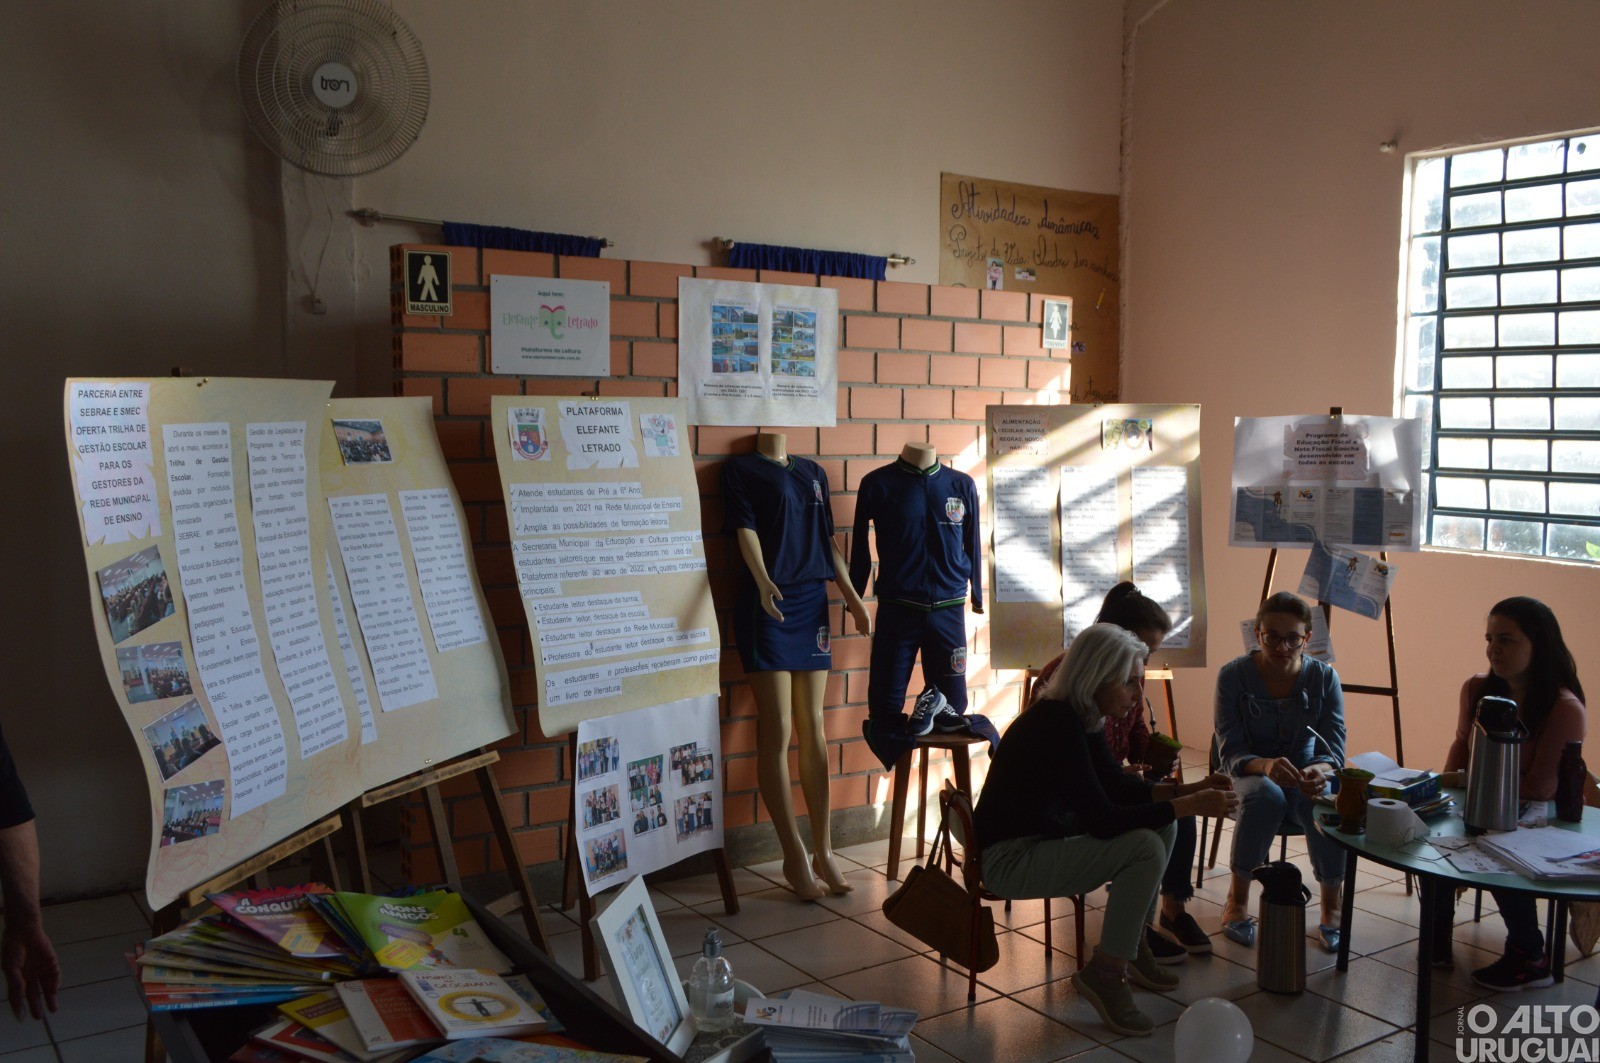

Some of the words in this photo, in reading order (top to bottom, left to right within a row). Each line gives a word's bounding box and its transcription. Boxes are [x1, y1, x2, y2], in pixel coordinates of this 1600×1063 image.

[321, 76, 350, 92] tron
[952, 180, 1030, 226] Atividades
[1038, 199, 1100, 239] dinâmicas
[410, 304, 449, 313] MASCULINO
[502, 313, 538, 330] Elefante
[568, 316, 598, 330] Letrado
[78, 390, 116, 398] PARCERIA
[118, 389, 143, 398] ENTRE
[80, 408, 111, 416] SEBRAE
[114, 408, 118, 416] E
[120, 406, 141, 415] SMEC
[566, 407, 623, 416] PLATAFORMA
[76, 426, 106, 435] OFERTA
[108, 425, 134, 434] TRILHA
[136, 424, 146, 432] DE
[576, 425, 620, 434] ELEFANTE
[79, 442, 111, 454] GESTÃO
[113, 442, 147, 451] ESCOLAR
[582, 444, 621, 453] LETRADO
[100, 462, 120, 470] PARA
[122, 460, 132, 469] OS
[208, 470, 230, 479] Formação
[92, 478, 132, 490] GESTORES
[134, 477, 144, 486] DA
[518, 489, 543, 497] Atende
[548, 488, 584, 496] estudantes
[598, 487, 610, 495] Pré
[90, 499, 110, 508] REDE
[112, 494, 151, 506] MUNICIPAL
[521, 504, 559, 514] Implantada
[576, 504, 591, 512] 2021
[606, 503, 622, 511] Rede
[624, 502, 652, 512] Municipal
[104, 516, 114, 525] DE
[116, 512, 142, 524] ENSINO
[524, 524, 547, 532] Amplia
[563, 520, 607, 531] possibilidades
[621, 518, 649, 529] formação
[522, 542, 556, 552] Secretaria
[559, 539, 590, 548] Municipal
[605, 537, 635, 547] Educação
[648, 535, 668, 544] Cultura
[671, 534, 693, 543] premiou
[518, 557, 556, 566] estudantes
[559, 554, 583, 562] leitores
[584, 555, 596, 563] que
[625, 549, 659, 558] destacaram
[522, 571, 558, 581] Plataforma
[559, 570, 588, 579] referente
[660, 564, 677, 573] quatro
[678, 561, 706, 571] categorias
[538, 602, 569, 611] Estudante
[588, 598, 613, 608] destaque
[542, 616, 572, 625] Estudante
[593, 612, 618, 621] destaque
[545, 632, 576, 642] Estudante
[579, 630, 593, 638] leitor
[595, 627, 620, 637] destaque
[634, 623, 647, 631] Rede
[547, 651, 580, 661] Professora
[595, 644, 622, 654] estudante
[625, 641, 638, 650] leitor
[640, 638, 664, 648] destaque
[546, 680, 555, 688] Os
[564, 672, 600, 684] estudantes
[651, 659, 681, 670] receberam
[566, 691, 579, 700] livro
[594, 685, 620, 695] literatura
[380, 908, 439, 920] AMIGOS
[384, 903, 427, 913] BONS
